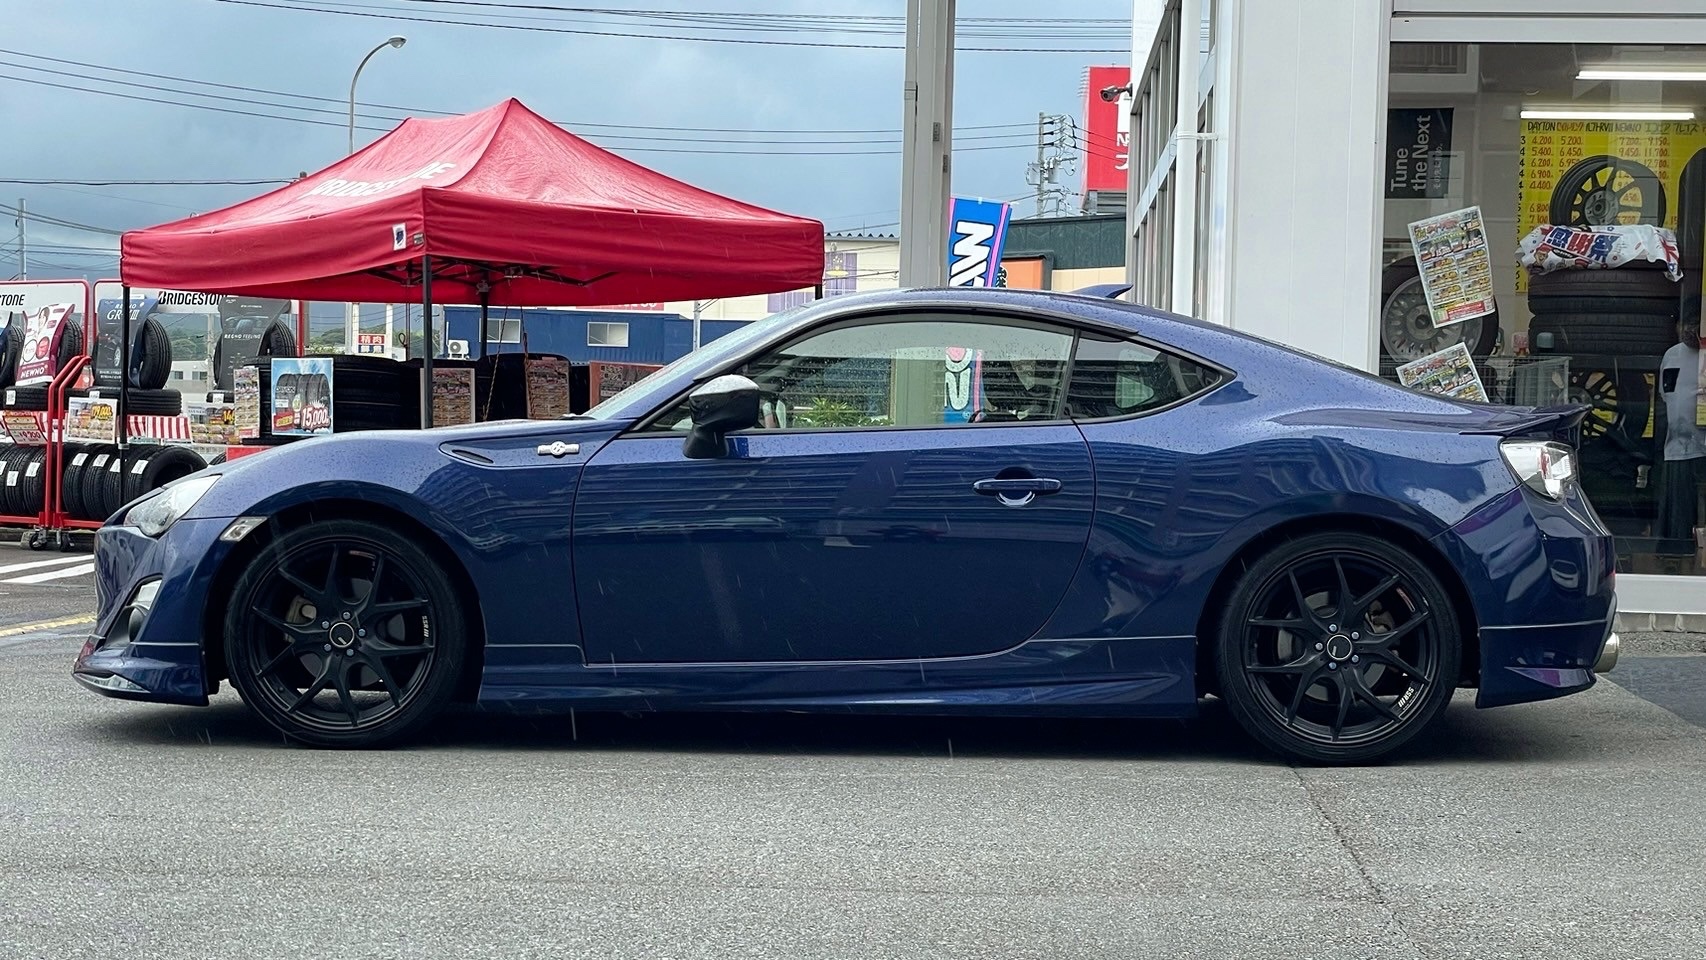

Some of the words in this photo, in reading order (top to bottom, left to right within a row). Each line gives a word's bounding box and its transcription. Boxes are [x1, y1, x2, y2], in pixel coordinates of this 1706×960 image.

[1412, 115, 1431, 158] Next
[1528, 121, 1555, 131] DAYTON
[1391, 148, 1408, 191] Tune
[1411, 161, 1427, 191] the
[0, 294, 25, 306] TONE
[20, 367, 45, 378] NEWNO
